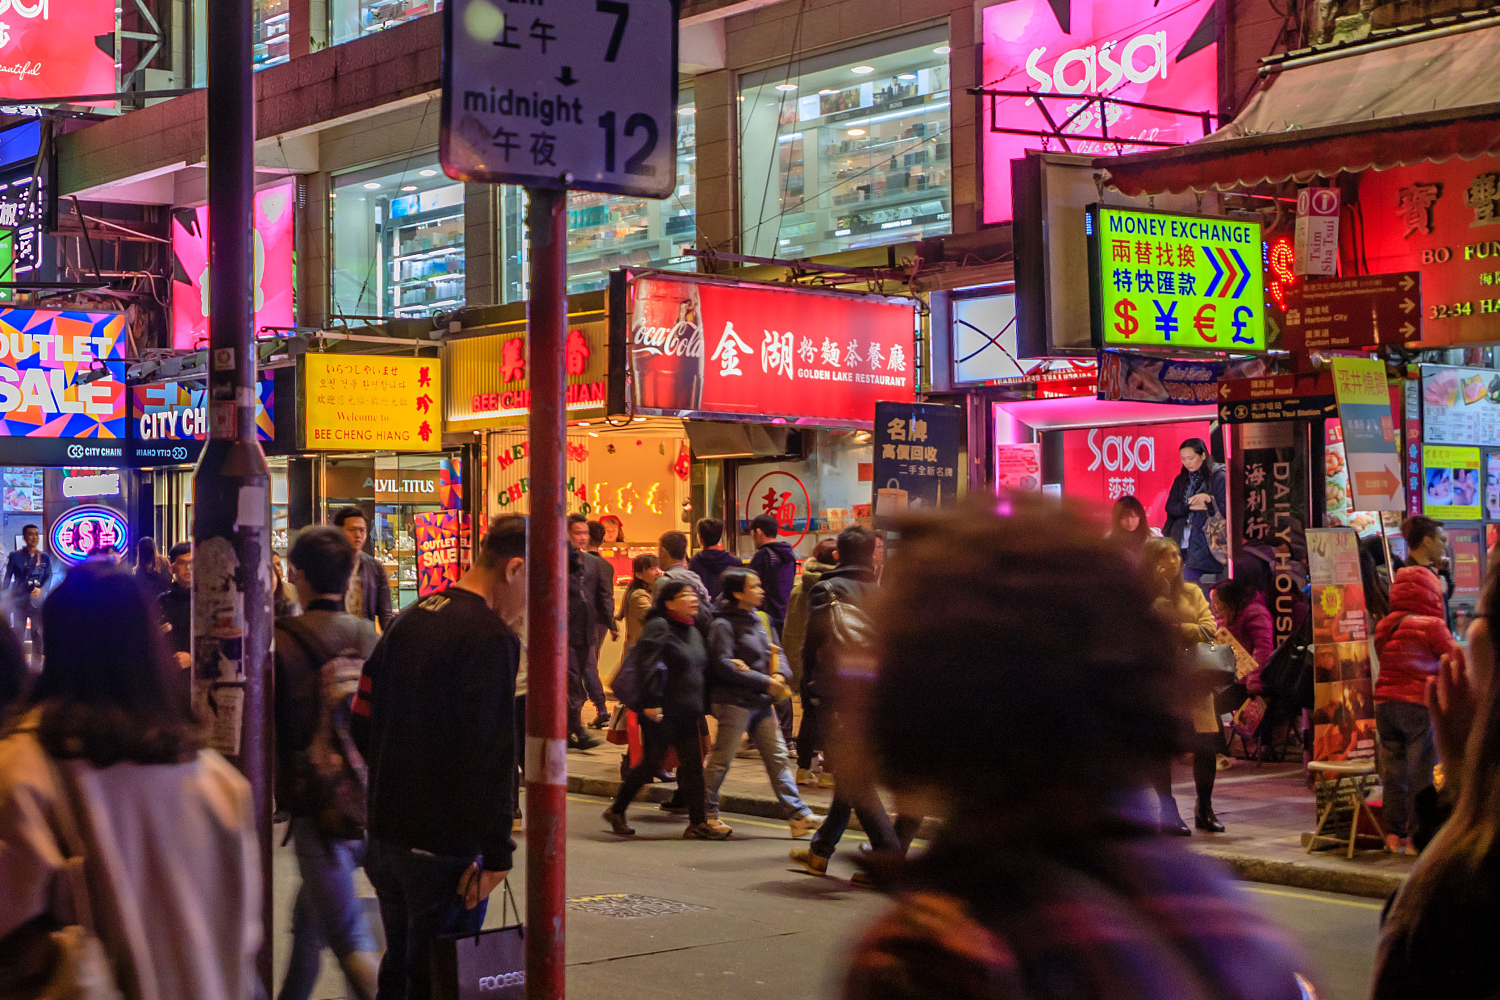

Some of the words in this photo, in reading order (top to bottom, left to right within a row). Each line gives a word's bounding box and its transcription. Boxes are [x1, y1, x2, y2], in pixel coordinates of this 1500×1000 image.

[492, 14, 557, 54] 上午
[596, 0, 629, 62] 7
[463, 87, 583, 126] midnight
[492, 127, 558, 167] 午夜
[598, 111, 658, 177] 12
[1109, 215, 1166, 236] MONEY
[1171, 220, 1251, 244] EXCHANGE
[1323, 220, 1335, 247] Tsui
[1112, 239, 1196, 268] 兩替找換
[1310, 231, 1322, 262] Tsim
[1421, 247, 1450, 265] BO
[1322, 250, 1333, 272] Sha
[1113, 268, 1197, 296] 特快匯款
[1333, 314, 1348, 322] City
[1429, 301, 1471, 319] 32-34
[711, 322, 794, 380] 金湖
[797, 335, 907, 374] 粉麵茶餐廳
[797, 367, 830, 381] GOLDEN
[832, 370, 853, 382] LAKE
[855, 373, 906, 387] RESTAURANT
[473, 392, 498, 412] BEE
[140, 410, 177, 440] CITY
[337, 411, 378, 421] Welcome
[314, 429, 331, 439] BEE
[335, 429, 372, 440] CHENG
[376, 430, 410, 441] HIANG
[887, 418, 928, 442] 名牌
[84, 448, 99, 456] CITY
[101, 448, 122, 456] CHAIN
[882, 444, 938, 463] 高價回收
[402, 480, 434, 492] TITUS
[1108, 477, 1135, 500] 莎莎
[1273, 462, 1291, 543] DAILY
[423, 538, 456, 550] OUTLET
[423, 548, 456, 566] SALE
